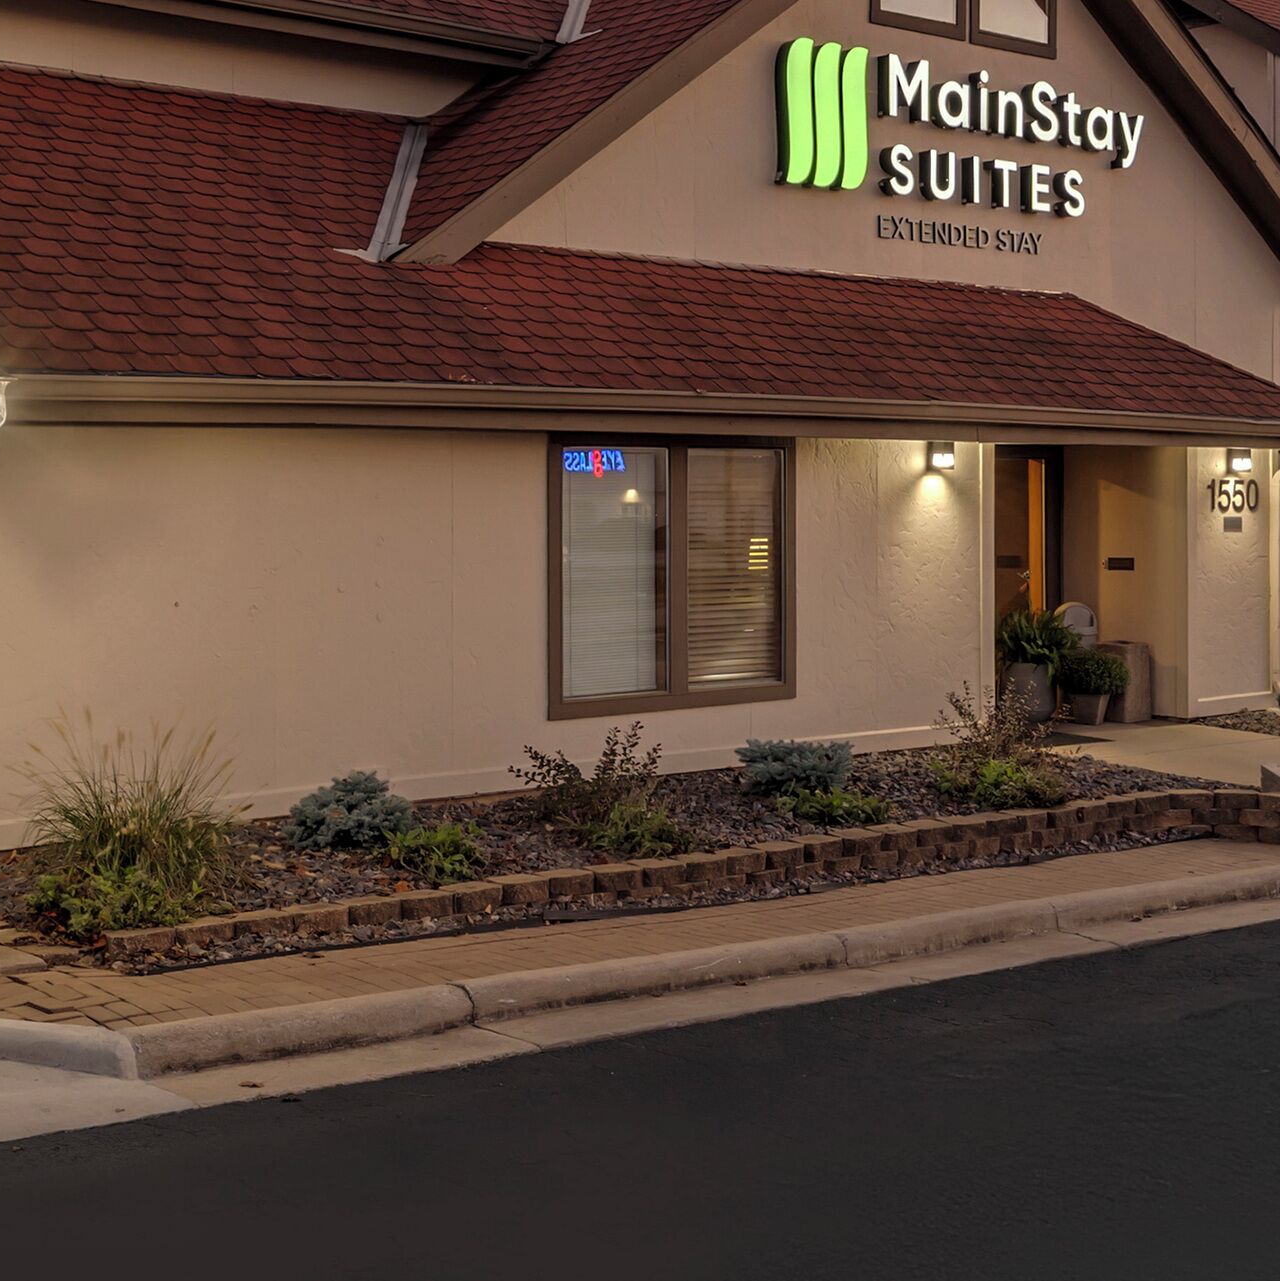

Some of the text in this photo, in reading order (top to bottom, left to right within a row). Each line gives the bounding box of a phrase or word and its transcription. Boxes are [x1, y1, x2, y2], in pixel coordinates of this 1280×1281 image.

[878, 53, 1144, 168] MainStay
[879, 144, 1086, 218] SUITES
[877, 214, 1044, 255] EXTENDED STAY
[1206, 478, 1259, 514] 1550
